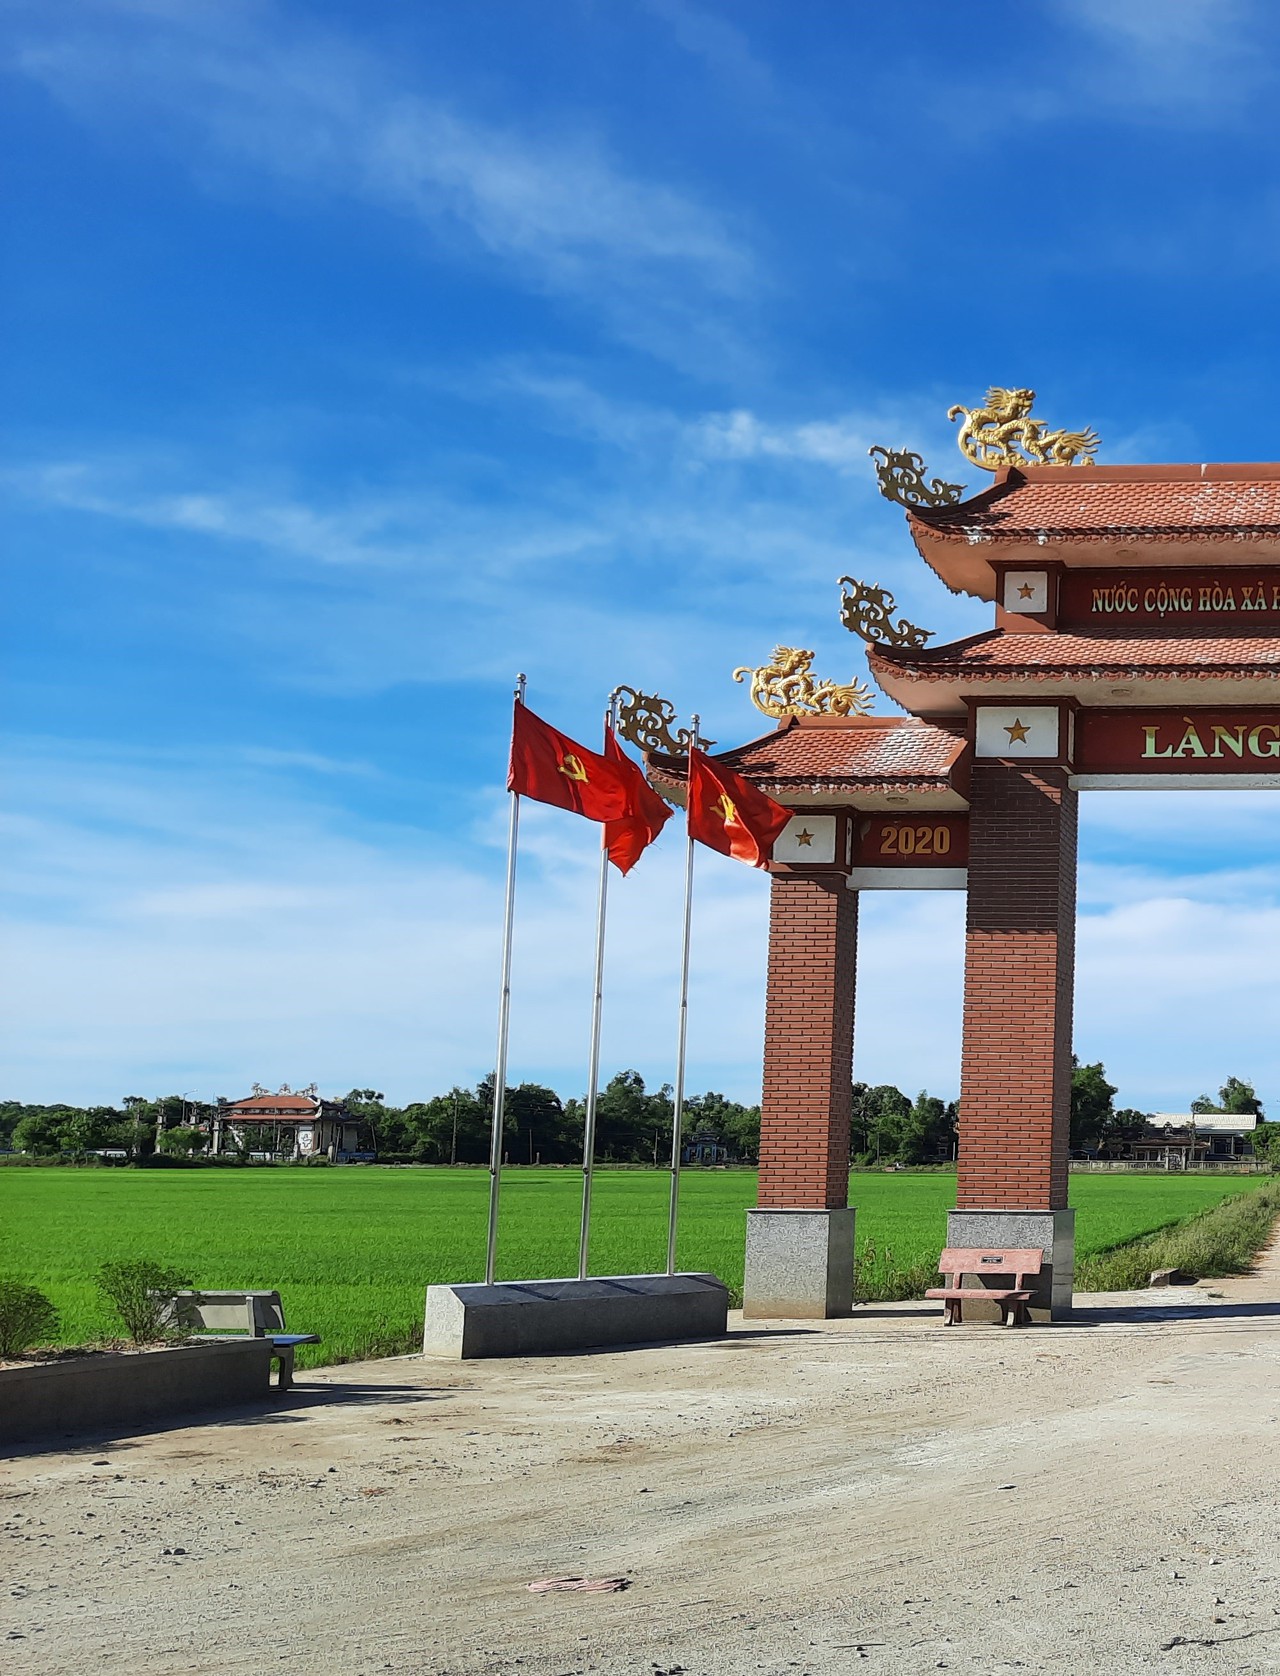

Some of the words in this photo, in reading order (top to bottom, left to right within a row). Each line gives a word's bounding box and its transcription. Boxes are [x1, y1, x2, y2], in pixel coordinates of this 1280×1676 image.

[1092, 581, 1139, 612] NƯỚC
[1144, 582, 1193, 617] CỘNG
[1198, 581, 1236, 611] HÒA
[1241, 581, 1267, 610] XÃ
[880, 826, 950, 854] 2020
